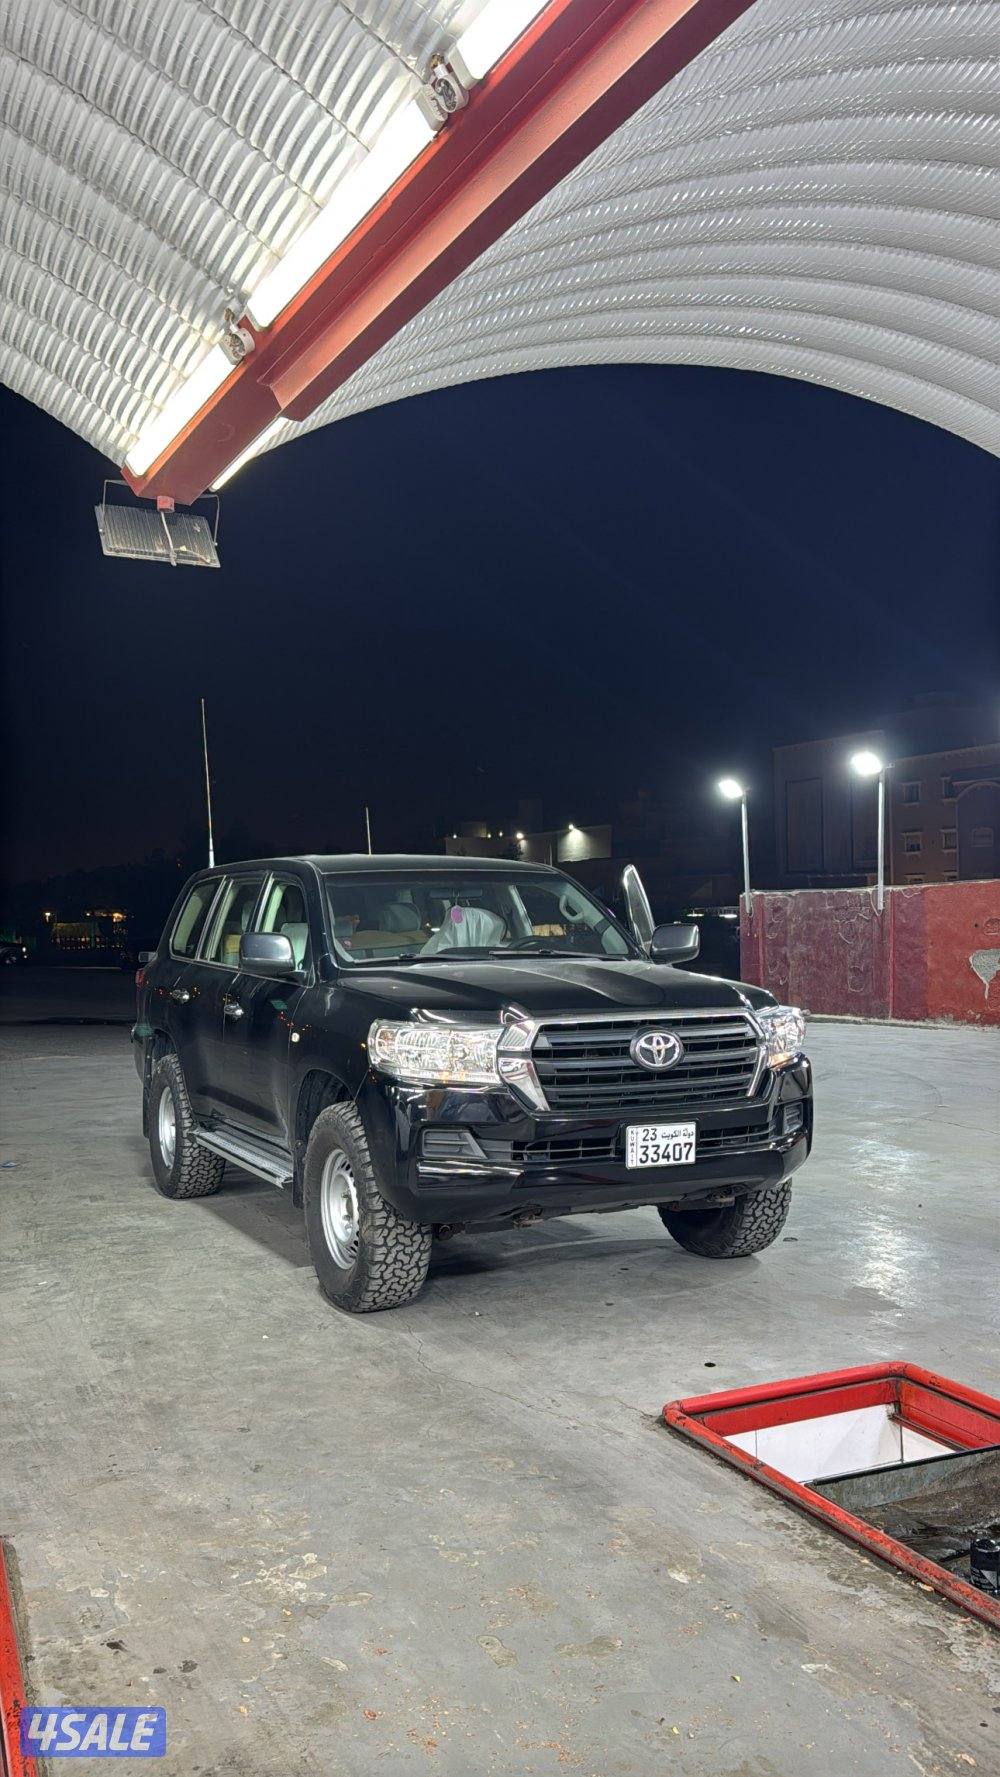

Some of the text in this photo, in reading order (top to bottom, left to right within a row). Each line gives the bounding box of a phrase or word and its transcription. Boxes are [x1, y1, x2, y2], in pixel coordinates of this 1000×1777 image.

[642, 1128, 658, 1142] 23
[661, 1130, 681, 1140] الكويت
[639, 1142, 693, 1164] 33407
